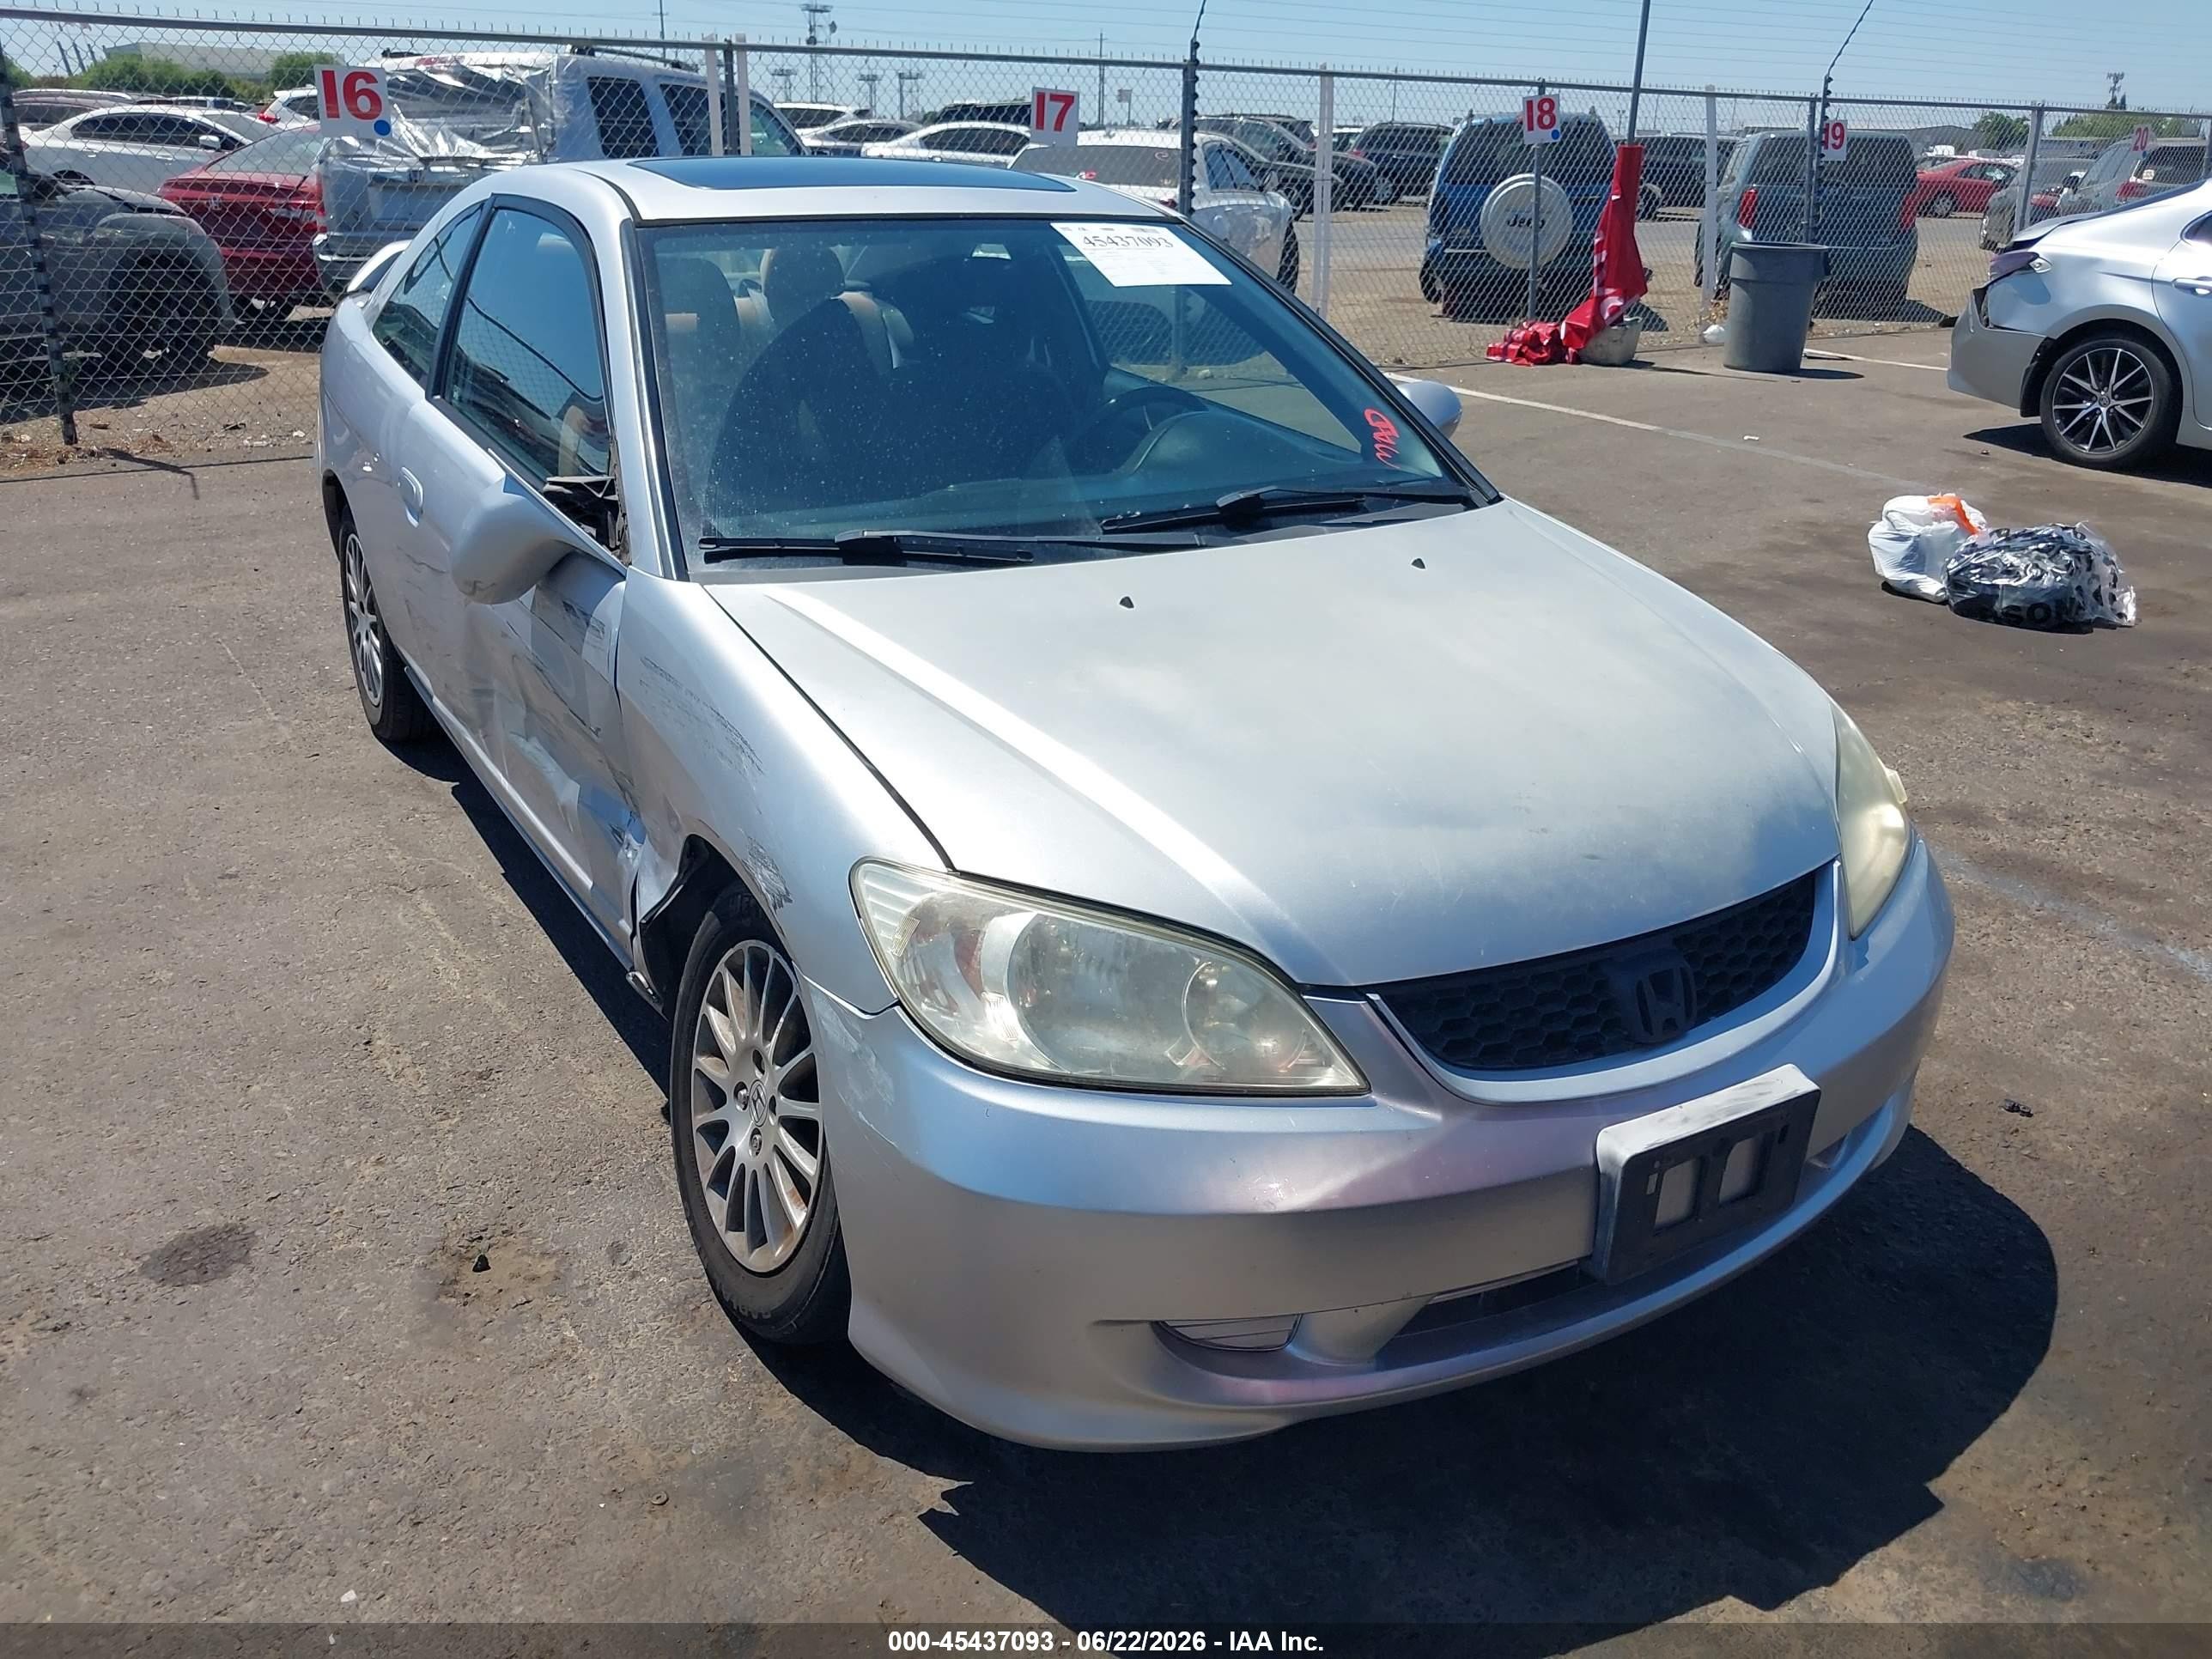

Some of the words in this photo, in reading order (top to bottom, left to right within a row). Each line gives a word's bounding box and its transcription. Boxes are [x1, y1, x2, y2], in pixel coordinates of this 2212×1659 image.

[322, 70, 382, 119] 16
[1036, 91, 1074, 131] 17
[1526, 98, 1556, 131] 18
[1823, 122, 1844, 150] 19
[2132, 126, 2148, 151] 20
[1084, 235, 1174, 247] 45437093
